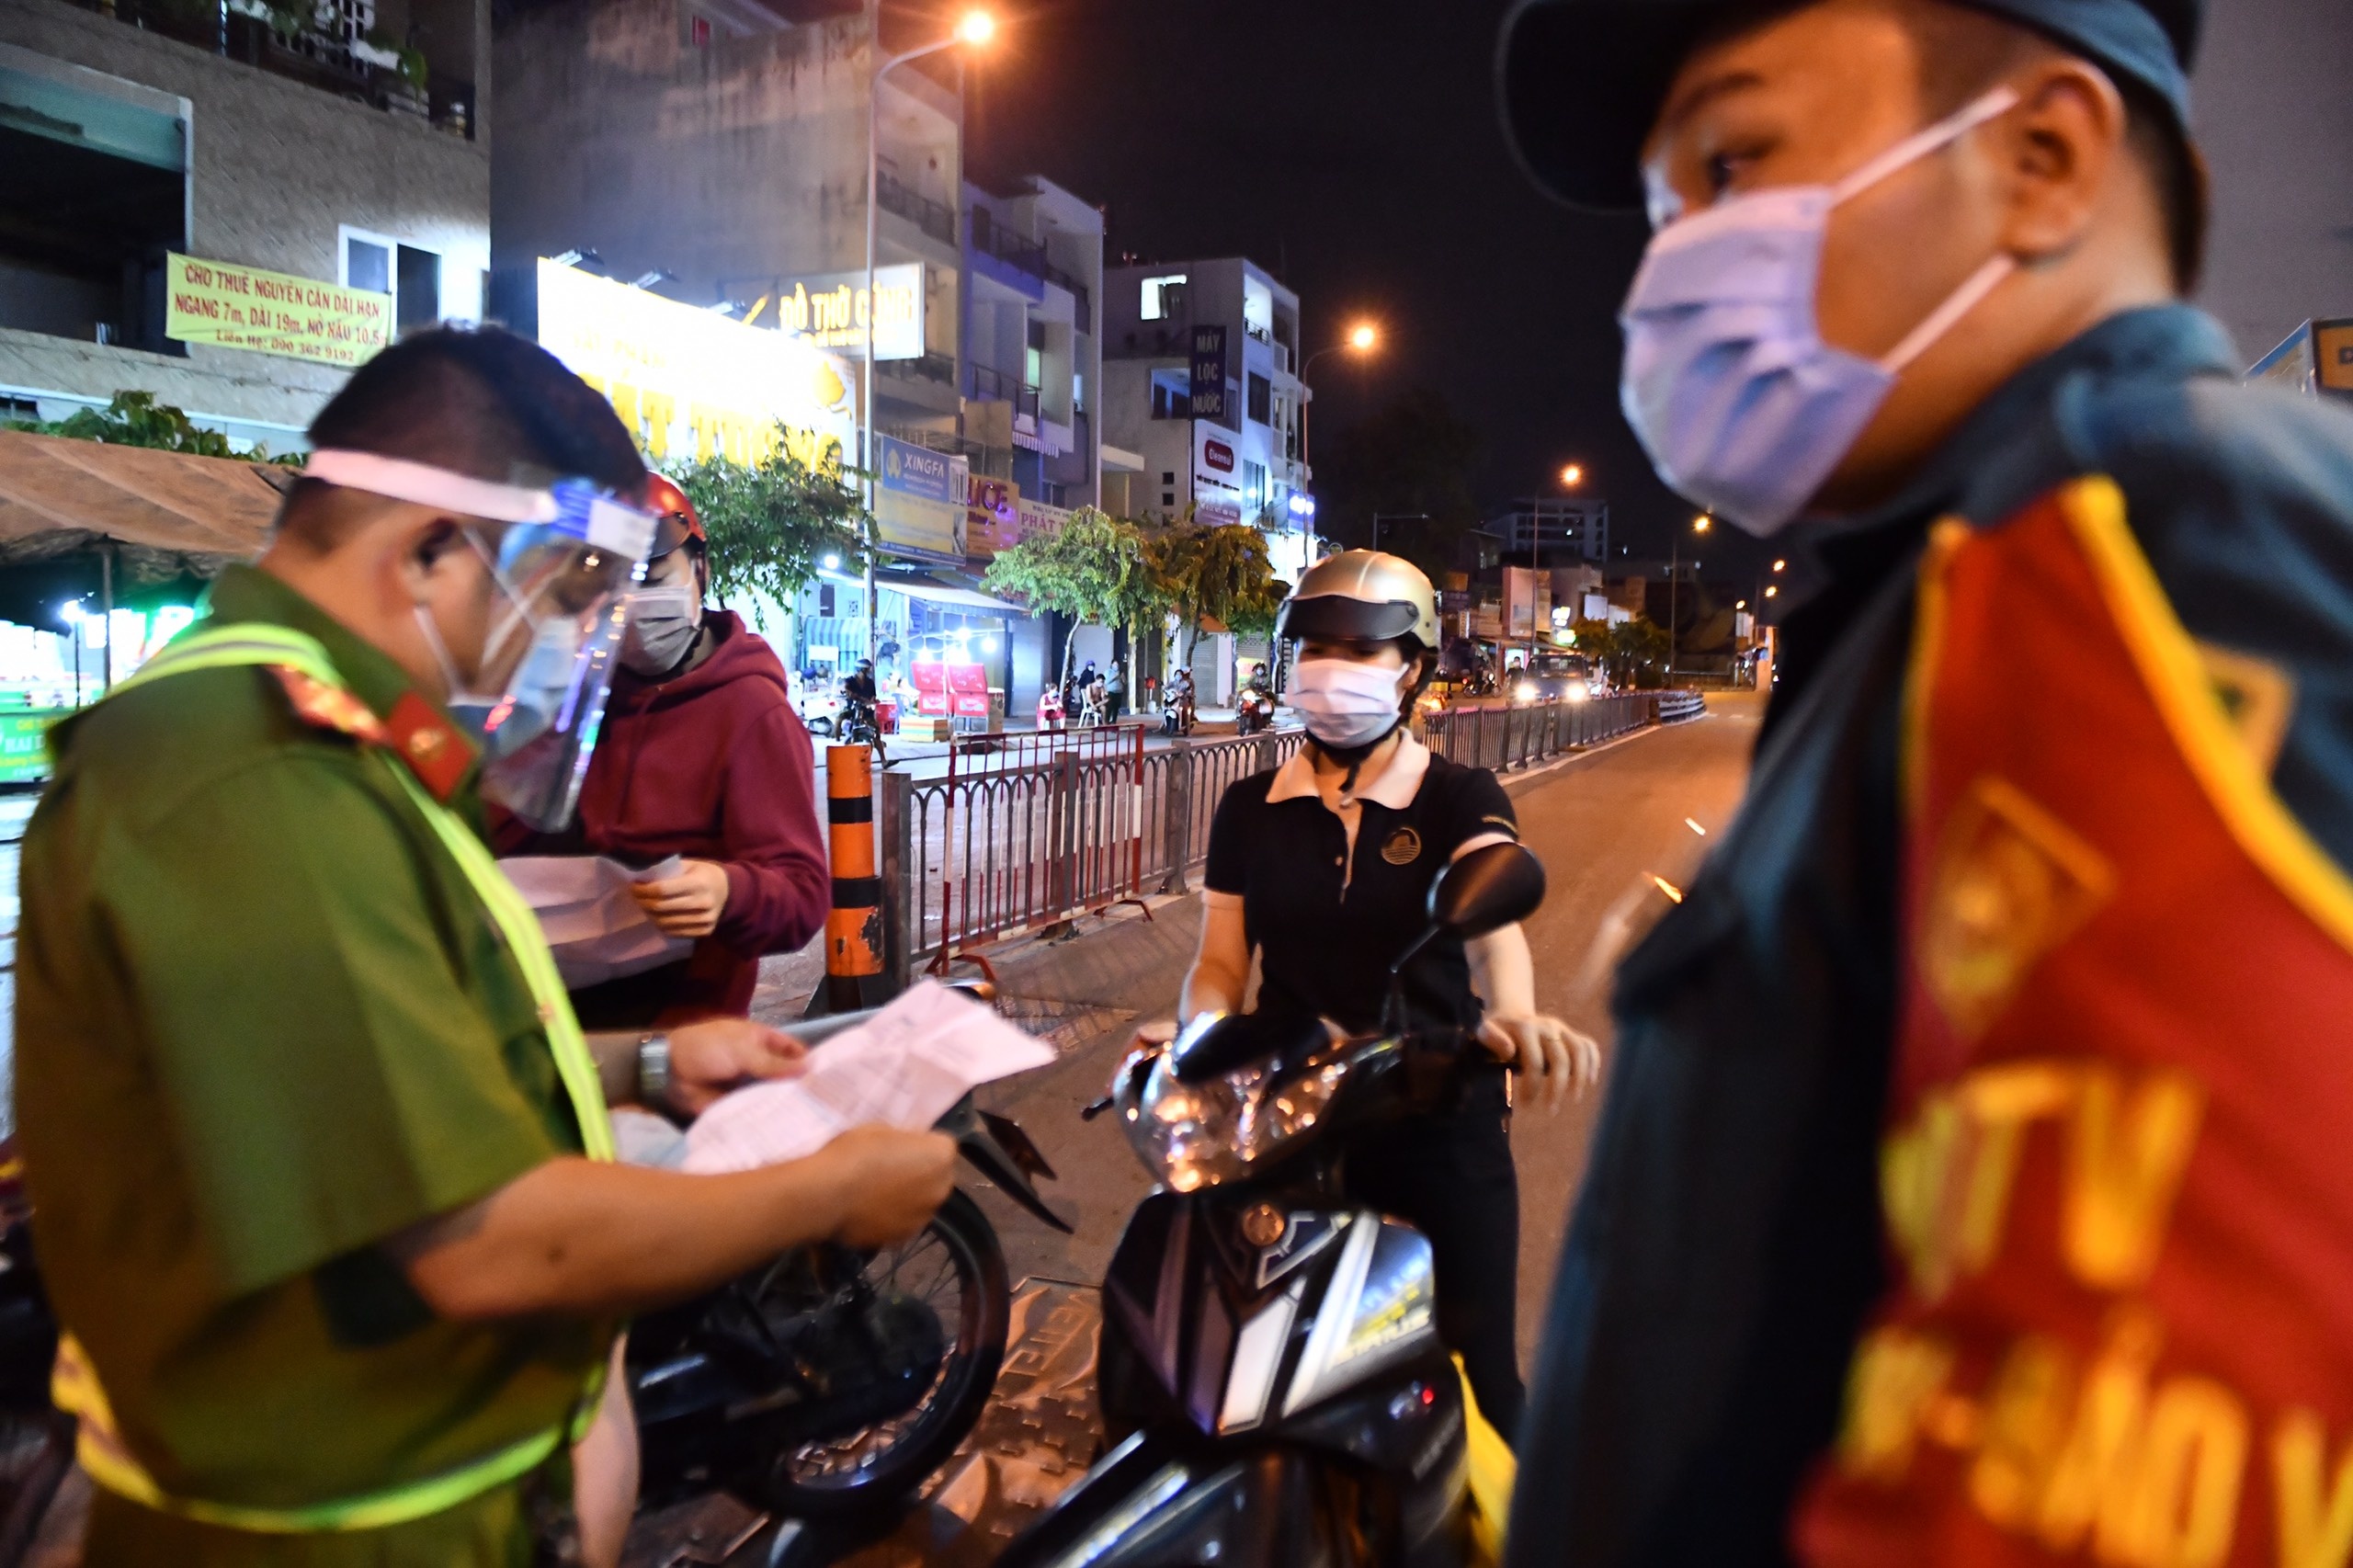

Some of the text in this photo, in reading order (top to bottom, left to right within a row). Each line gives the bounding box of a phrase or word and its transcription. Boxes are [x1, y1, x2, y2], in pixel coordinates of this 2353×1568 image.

[185, 264, 212, 287] CHO
[216, 270, 249, 295] THUÊ
[175, 292, 219, 319] NGANG
[249, 303, 271, 329] DÀI
[1197, 332, 1221, 353] MÁY
[1198, 363, 1219, 384] LỌC
[1192, 390, 1222, 414] NƯỚC
[904, 452, 944, 478] XINGFA
